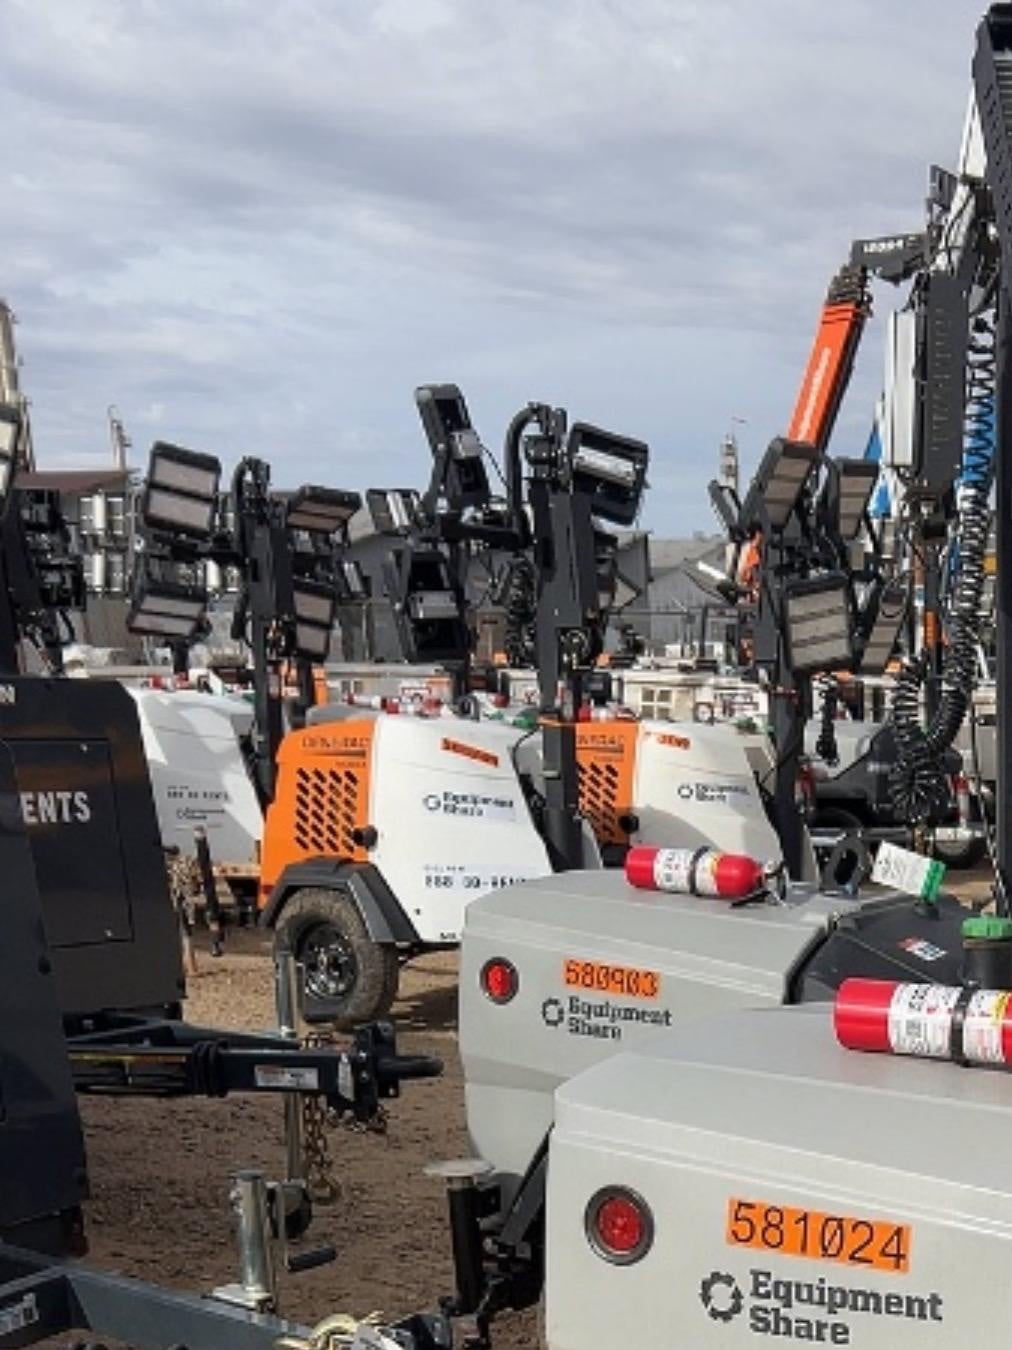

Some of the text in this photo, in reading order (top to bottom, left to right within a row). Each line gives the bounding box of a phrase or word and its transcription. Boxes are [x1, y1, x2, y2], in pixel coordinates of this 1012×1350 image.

[19, 790, 91, 825] ENTS
[565, 959, 658, 997] 580903
[568, 995, 673, 1027] Equipment
[568, 1016, 622, 1041] Share
[731, 1199, 906, 1270] 581024
[749, 1268, 944, 1321] Equipment
[749, 1304, 851, 1345] Share
